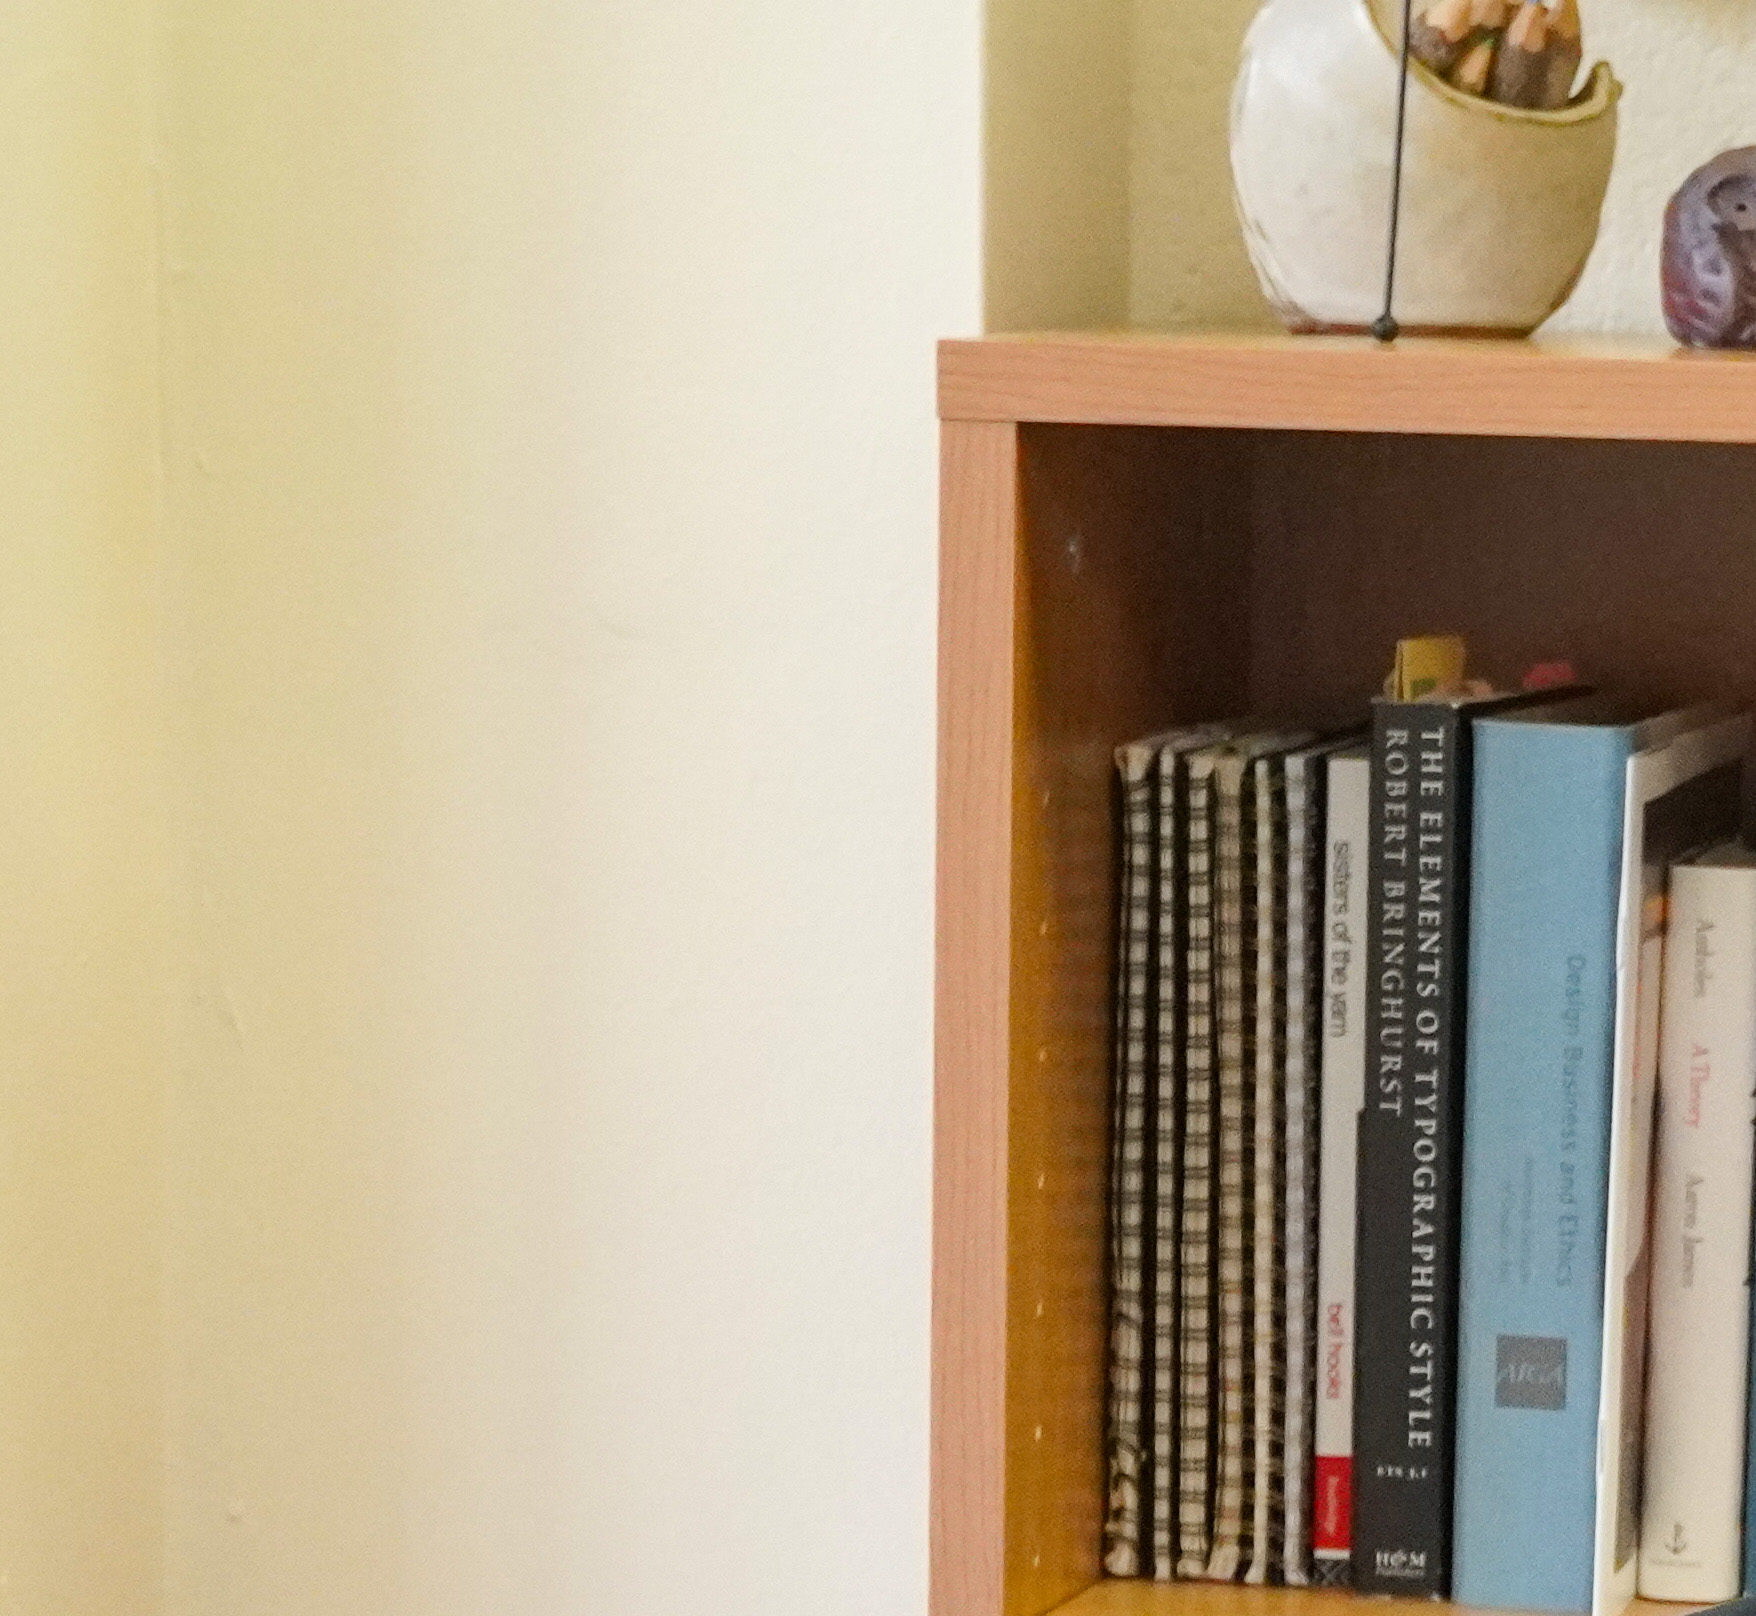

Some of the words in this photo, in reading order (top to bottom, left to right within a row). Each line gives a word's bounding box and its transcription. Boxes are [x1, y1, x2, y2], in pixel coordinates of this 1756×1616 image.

[1383, 728, 1410, 867] ROBERT
[1420, 726, 1445, 797] THE
[1332, 839, 1351, 916] sisters
[1417, 811, 1443, 998] ELEMENTS
[1331, 921, 1351, 945] of
[1331, 951, 1351, 986] the
[1328, 991, 1348, 1038] yarn
[1379, 879, 1406, 1117] BRINGHURST
[1415, 1009, 1440, 1056] OF
[1560, 954, 1587, 1038] Design
[1558, 1045, 1584, 1153] Business
[1410, 1068, 1438, 1330] TYPOGRAPHIC
[1556, 1159, 1577, 1208] and
[1555, 1214, 1579, 1289] Ethics
[1407, 1340, 1434, 1449] STYLE
